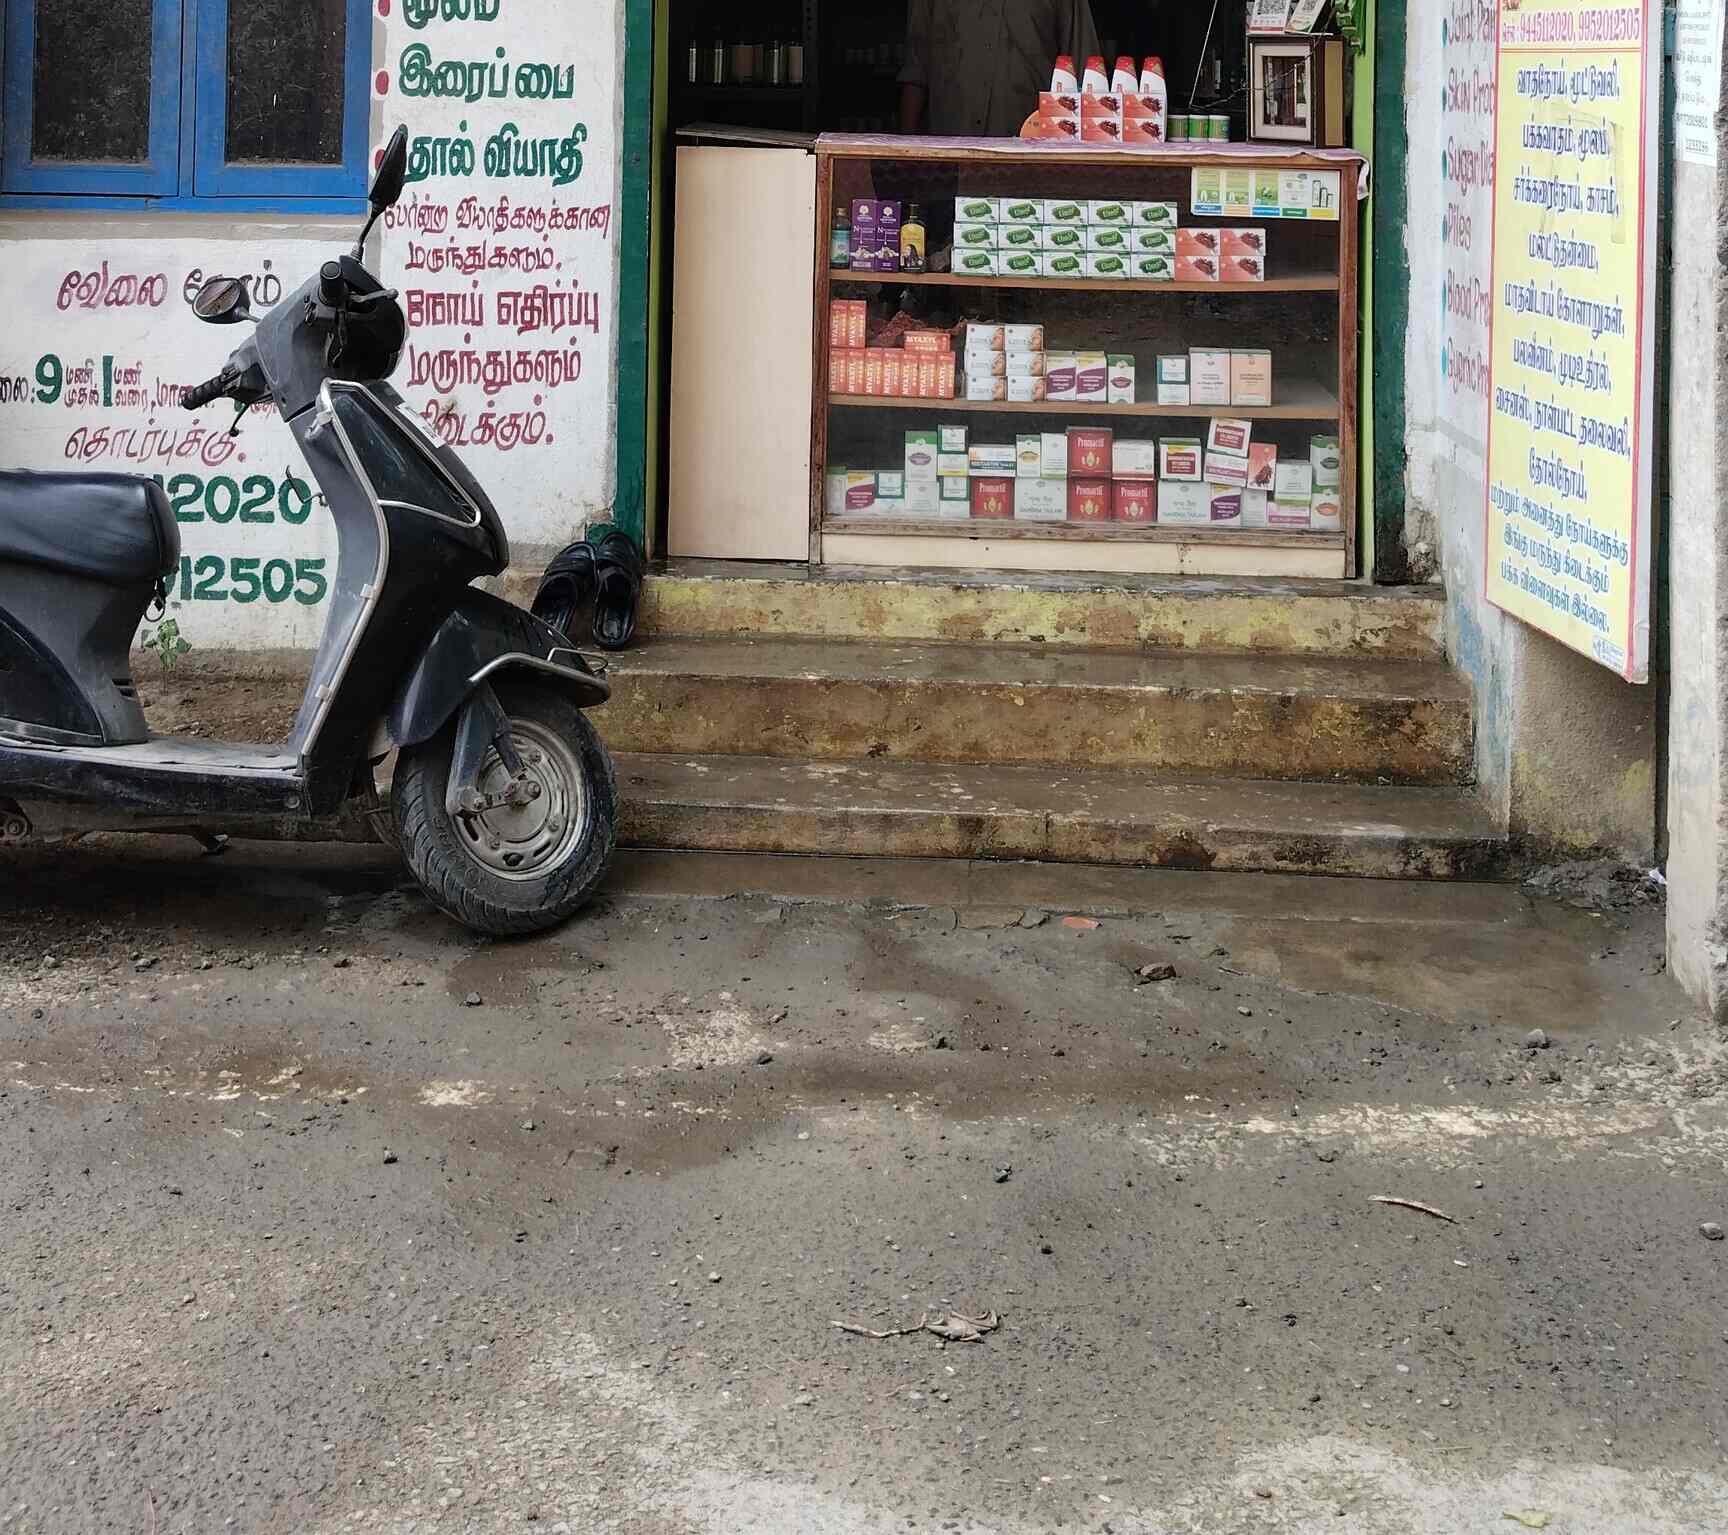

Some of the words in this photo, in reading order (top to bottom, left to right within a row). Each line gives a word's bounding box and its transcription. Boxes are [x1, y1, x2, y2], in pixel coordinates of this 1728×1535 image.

[483, 122, 588, 187] வியாதி
[56, 260, 169, 312] வேலை
[405, 280, 484, 327] நோய்
[496, 278, 600, 336] எதிர்ப்பு
[35, 353, 63, 404] 9
[406, 332, 581, 394] மருந்துகளும்
